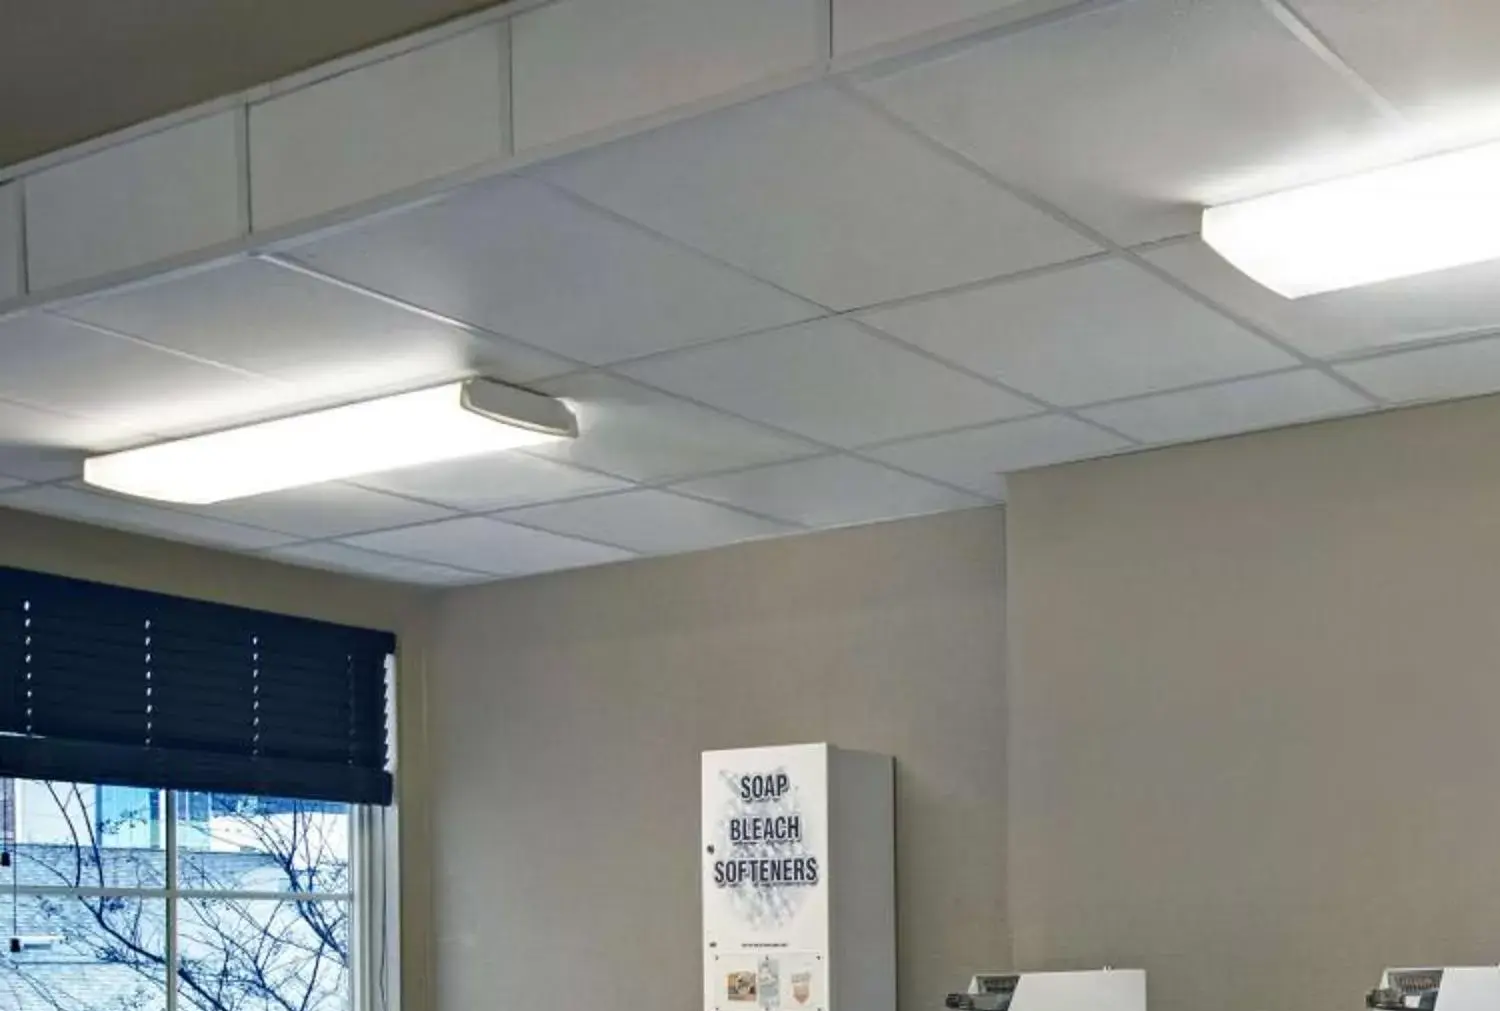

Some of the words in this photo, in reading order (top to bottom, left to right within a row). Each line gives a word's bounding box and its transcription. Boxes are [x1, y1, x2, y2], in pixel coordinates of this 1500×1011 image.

[740, 774, 789, 799] SOAP
[730, 815, 801, 841] BLEACH
[714, 857, 818, 883] SOFTENERS
